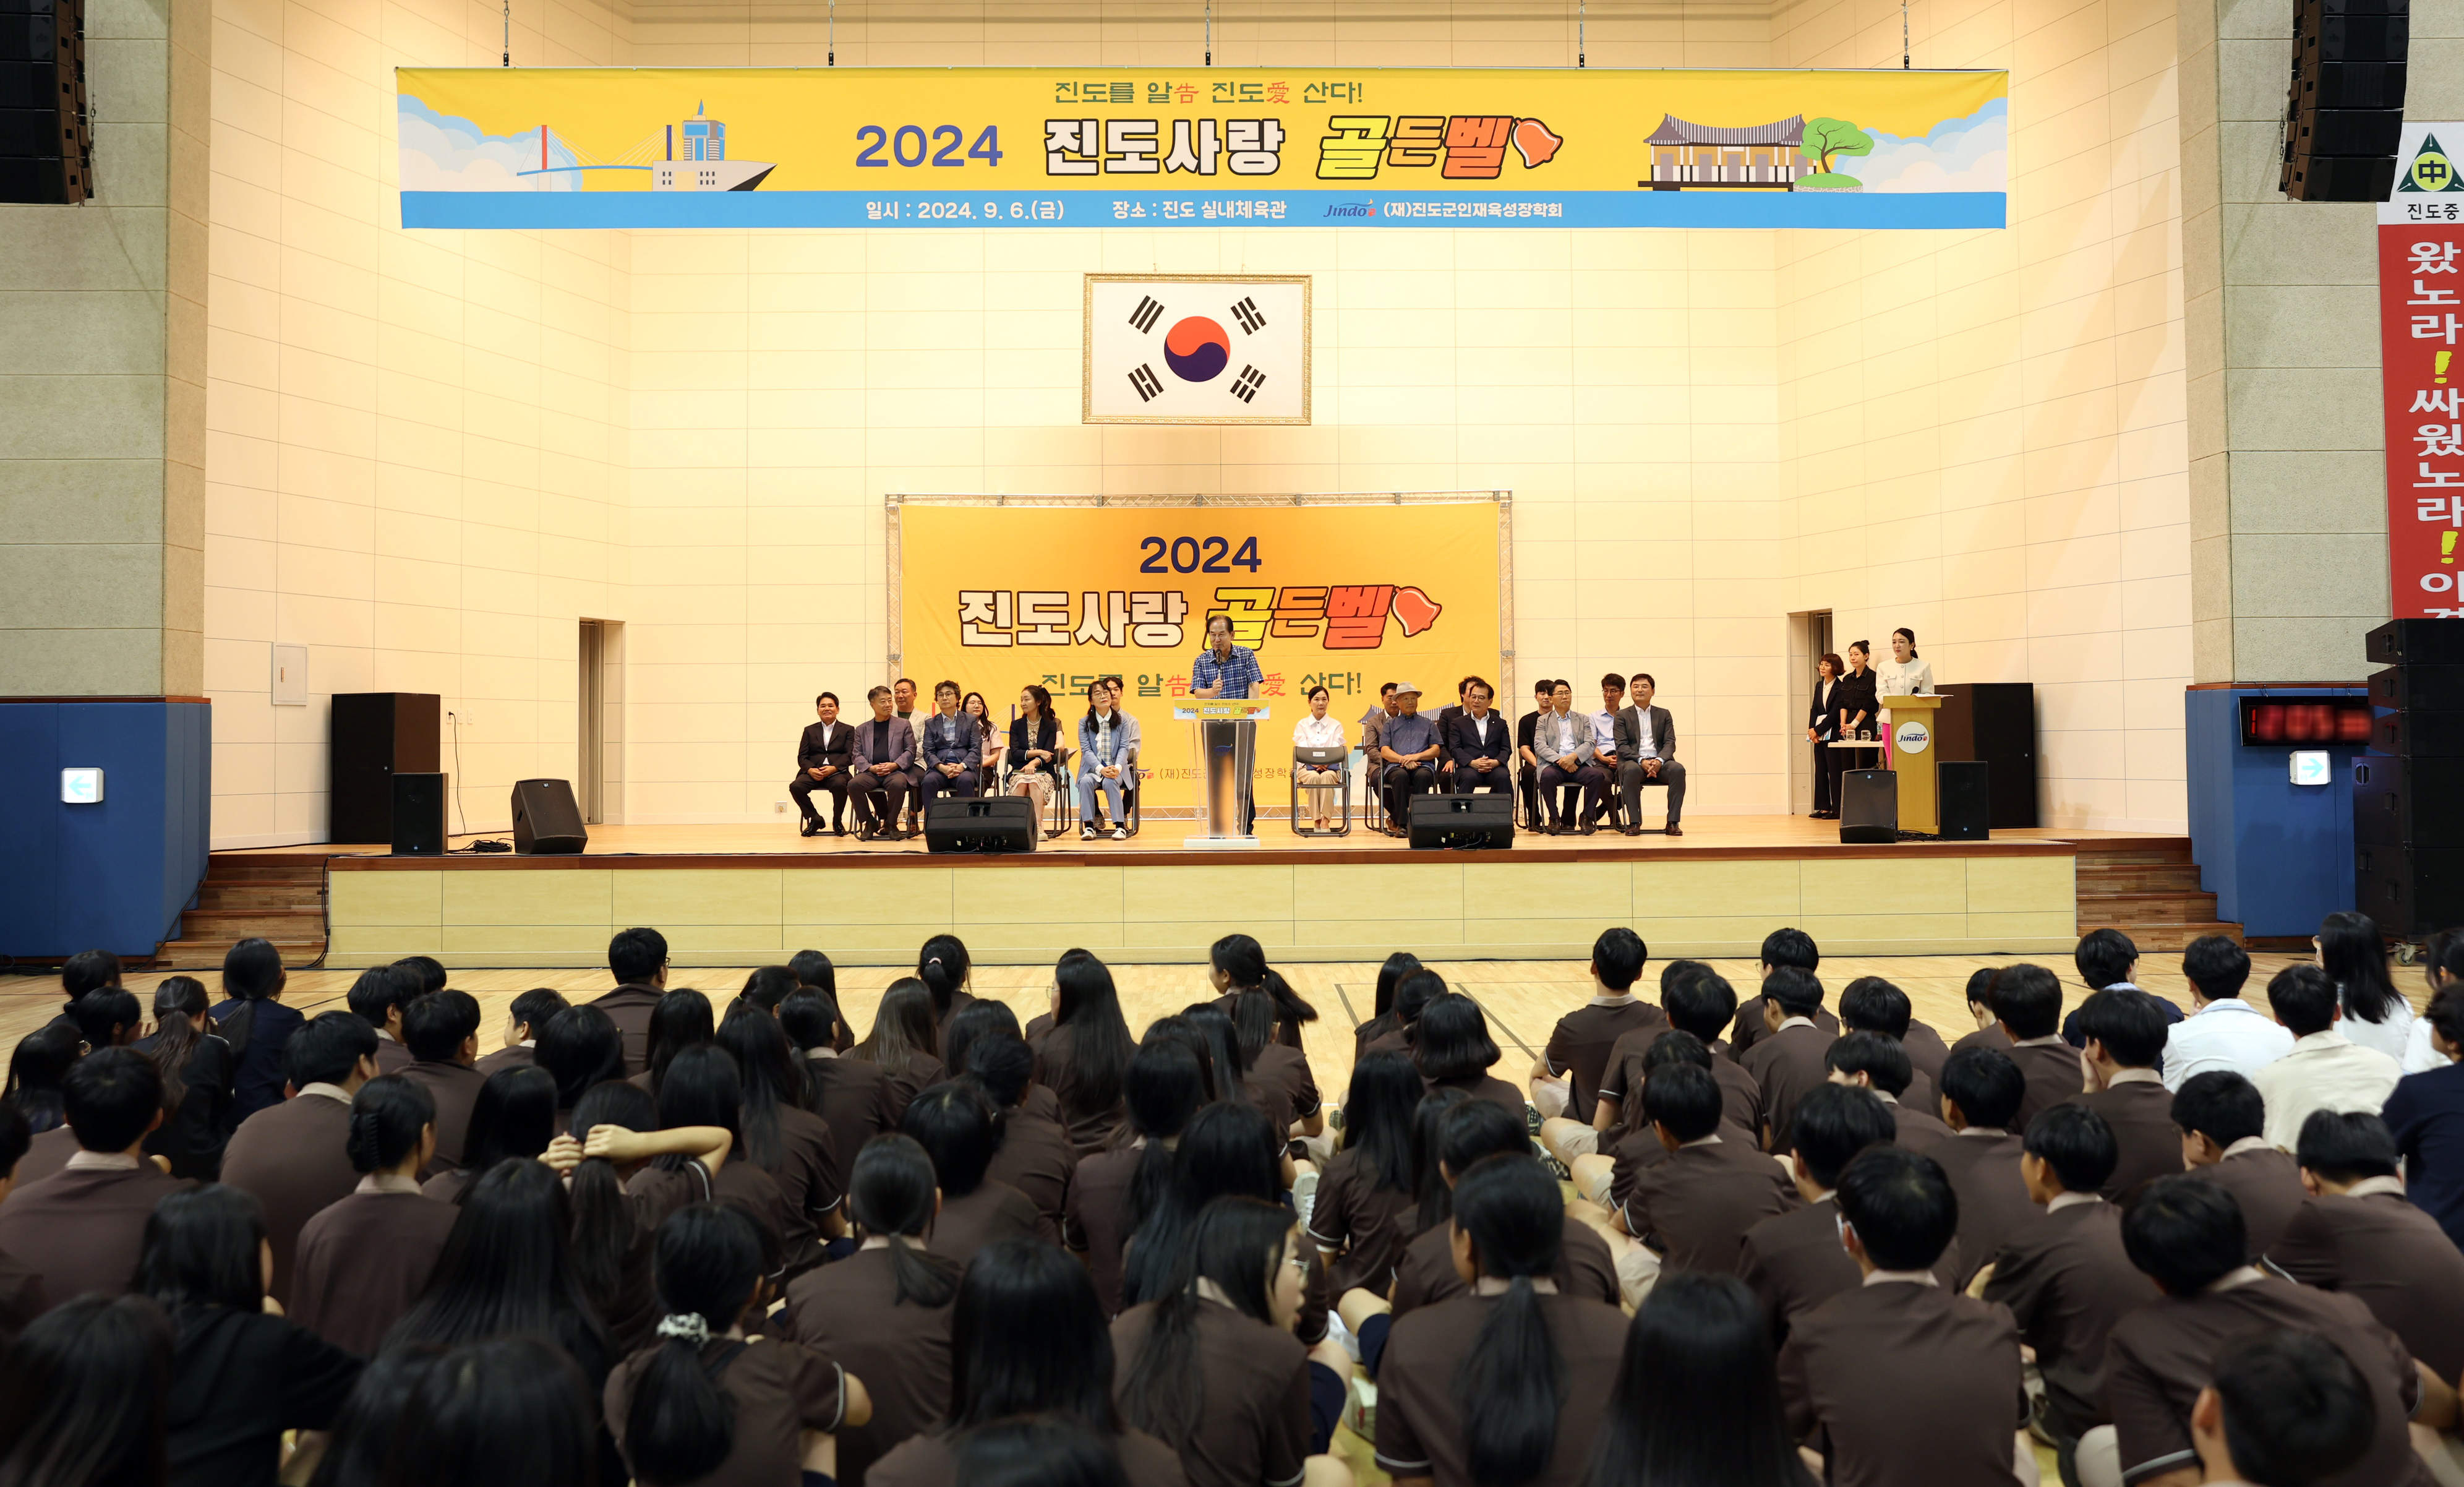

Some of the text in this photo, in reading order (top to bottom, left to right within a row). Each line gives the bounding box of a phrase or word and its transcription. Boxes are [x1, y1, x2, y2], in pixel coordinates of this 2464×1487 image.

[1055, 81, 1362, 104] 진도를 알告 진도愛 산다!
[856, 115, 1513, 180] 2024 진도사랑 골든벨
[2418, 160, 2447, 183] 中
[865, 201, 899, 220] 일시
[918, 202, 978, 220] 2024.
[984, 202, 1004, 220] 9.
[1010, 200, 1065, 220] 6.(금)
[1112, 201, 1147, 219] 장소
[1162, 200, 1197, 219] 진도
[1200, 200, 1288, 219] 실내체육관
[1324, 203, 1367, 218] Jindo
[1384, 202, 1564, 218] (재)진도군인재육성장학회
[1139, 536, 1262, 574] 2024
[958, 585, 1396, 651] 진도사랑 골든벨
[1300, 672, 1362, 695] 산다!
[1897, 734, 1923, 742] Jindo
